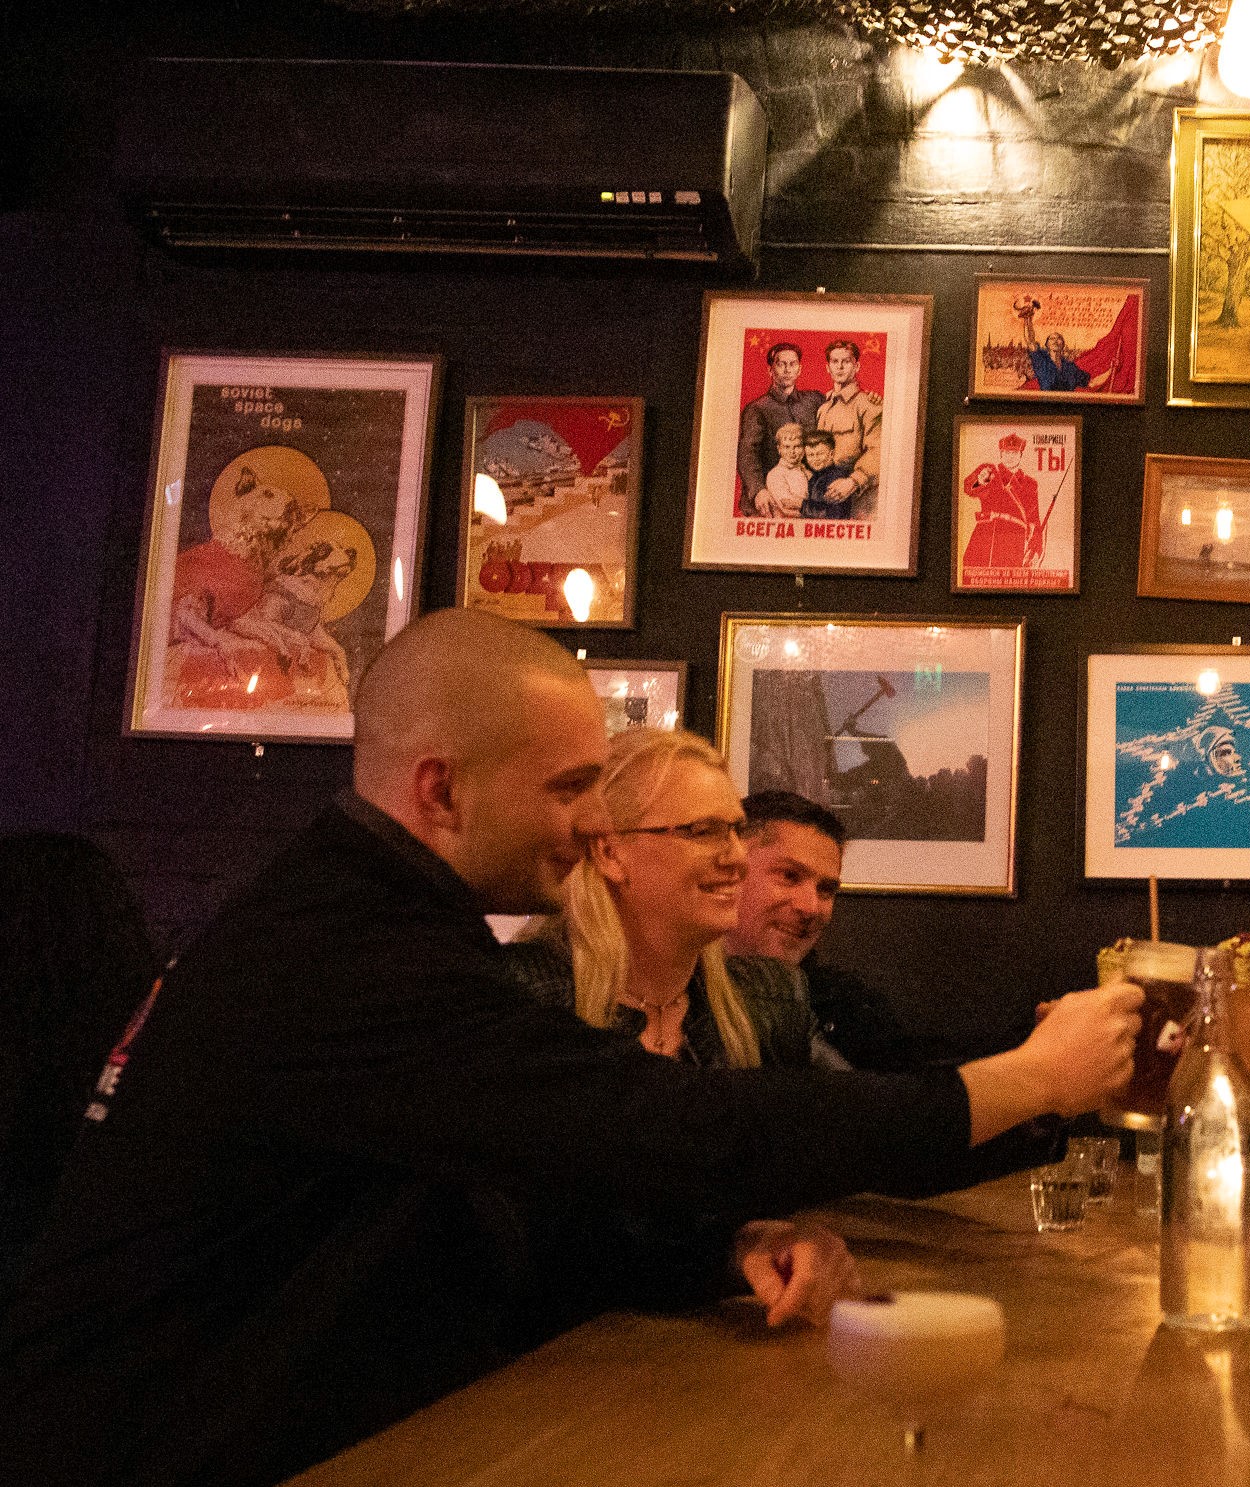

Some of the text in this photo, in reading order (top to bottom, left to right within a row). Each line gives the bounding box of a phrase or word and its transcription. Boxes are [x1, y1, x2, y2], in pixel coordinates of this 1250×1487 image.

[221, 386, 272, 399] soviet
[235, 401, 284, 415] space
[261, 415, 302, 431] dogs
[1034, 447, 1066, 471] ТЫ
[736, 521, 872, 540] ВСЕГДА ВМЕСТЕ!
